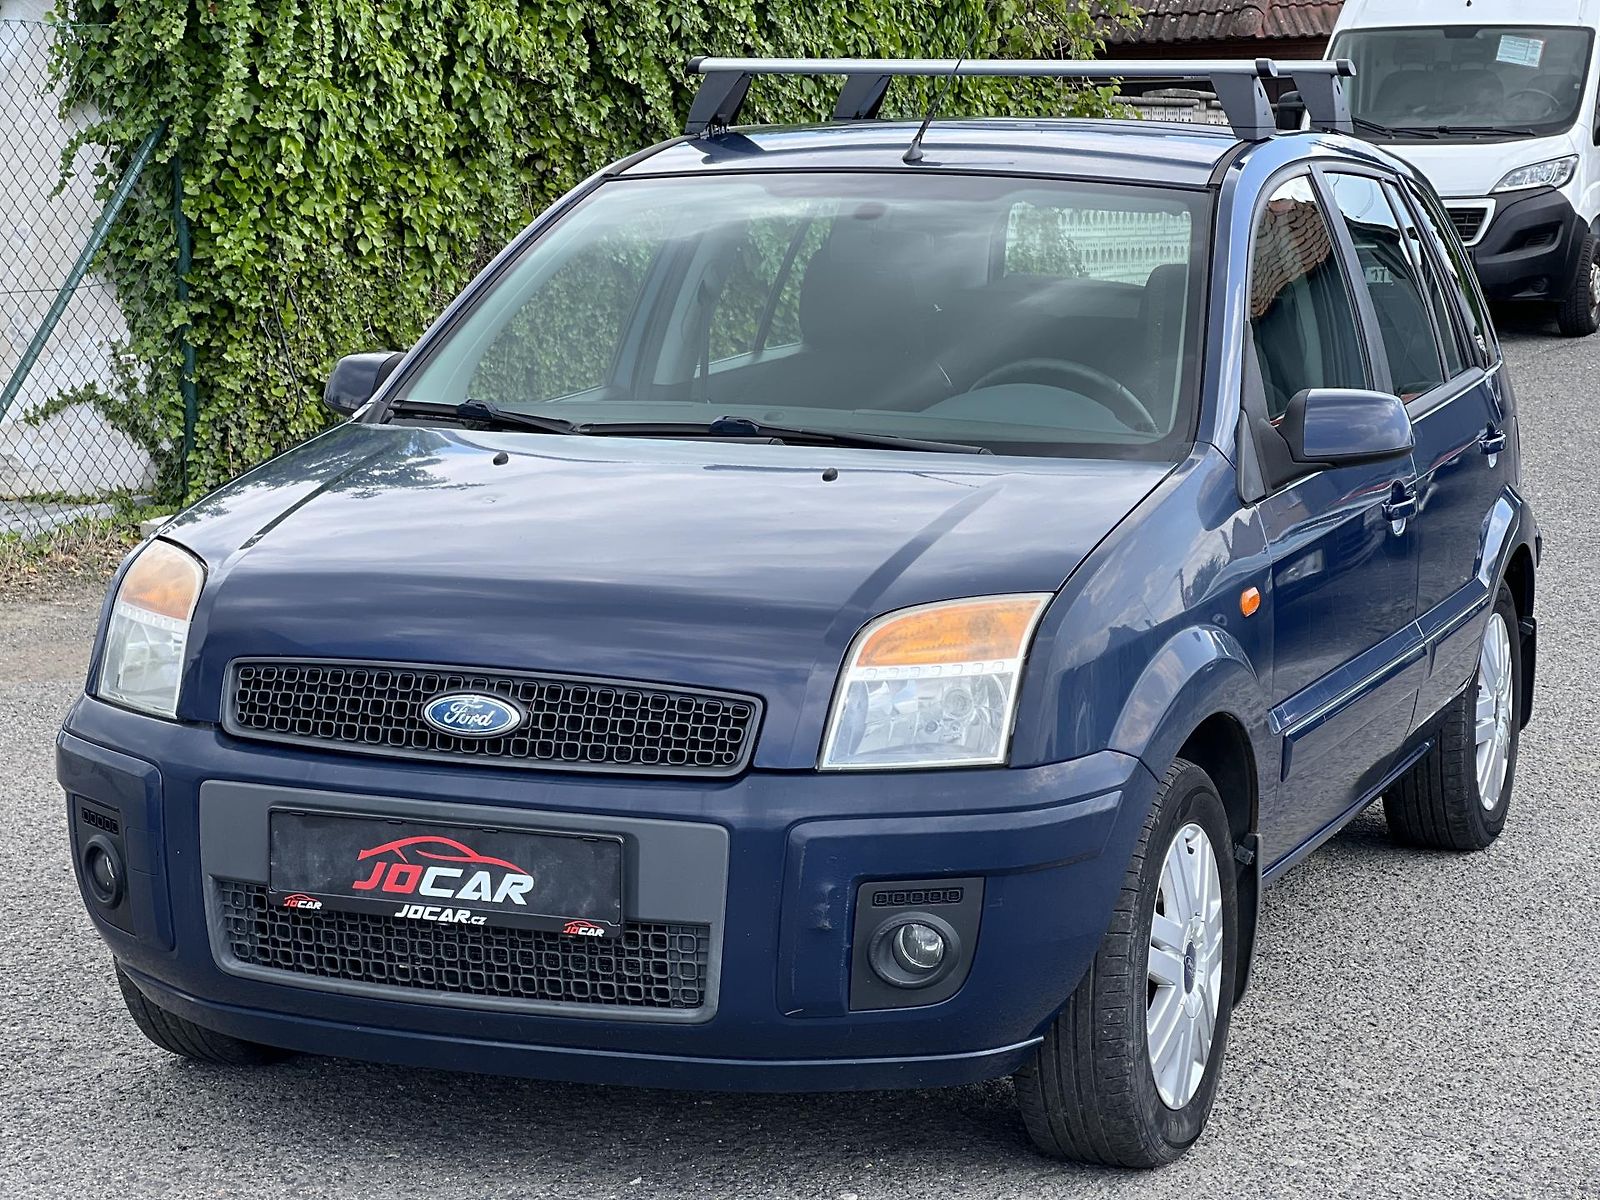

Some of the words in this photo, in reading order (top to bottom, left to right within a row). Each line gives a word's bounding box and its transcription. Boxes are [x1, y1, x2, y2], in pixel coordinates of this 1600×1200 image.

[444, 701, 495, 727] Ford
[352, 861, 535, 906] JOCAR
[283, 899, 322, 910] JOCAR
[394, 904, 487, 926] JOCAR.cz
[563, 926, 605, 937] JOCAR
